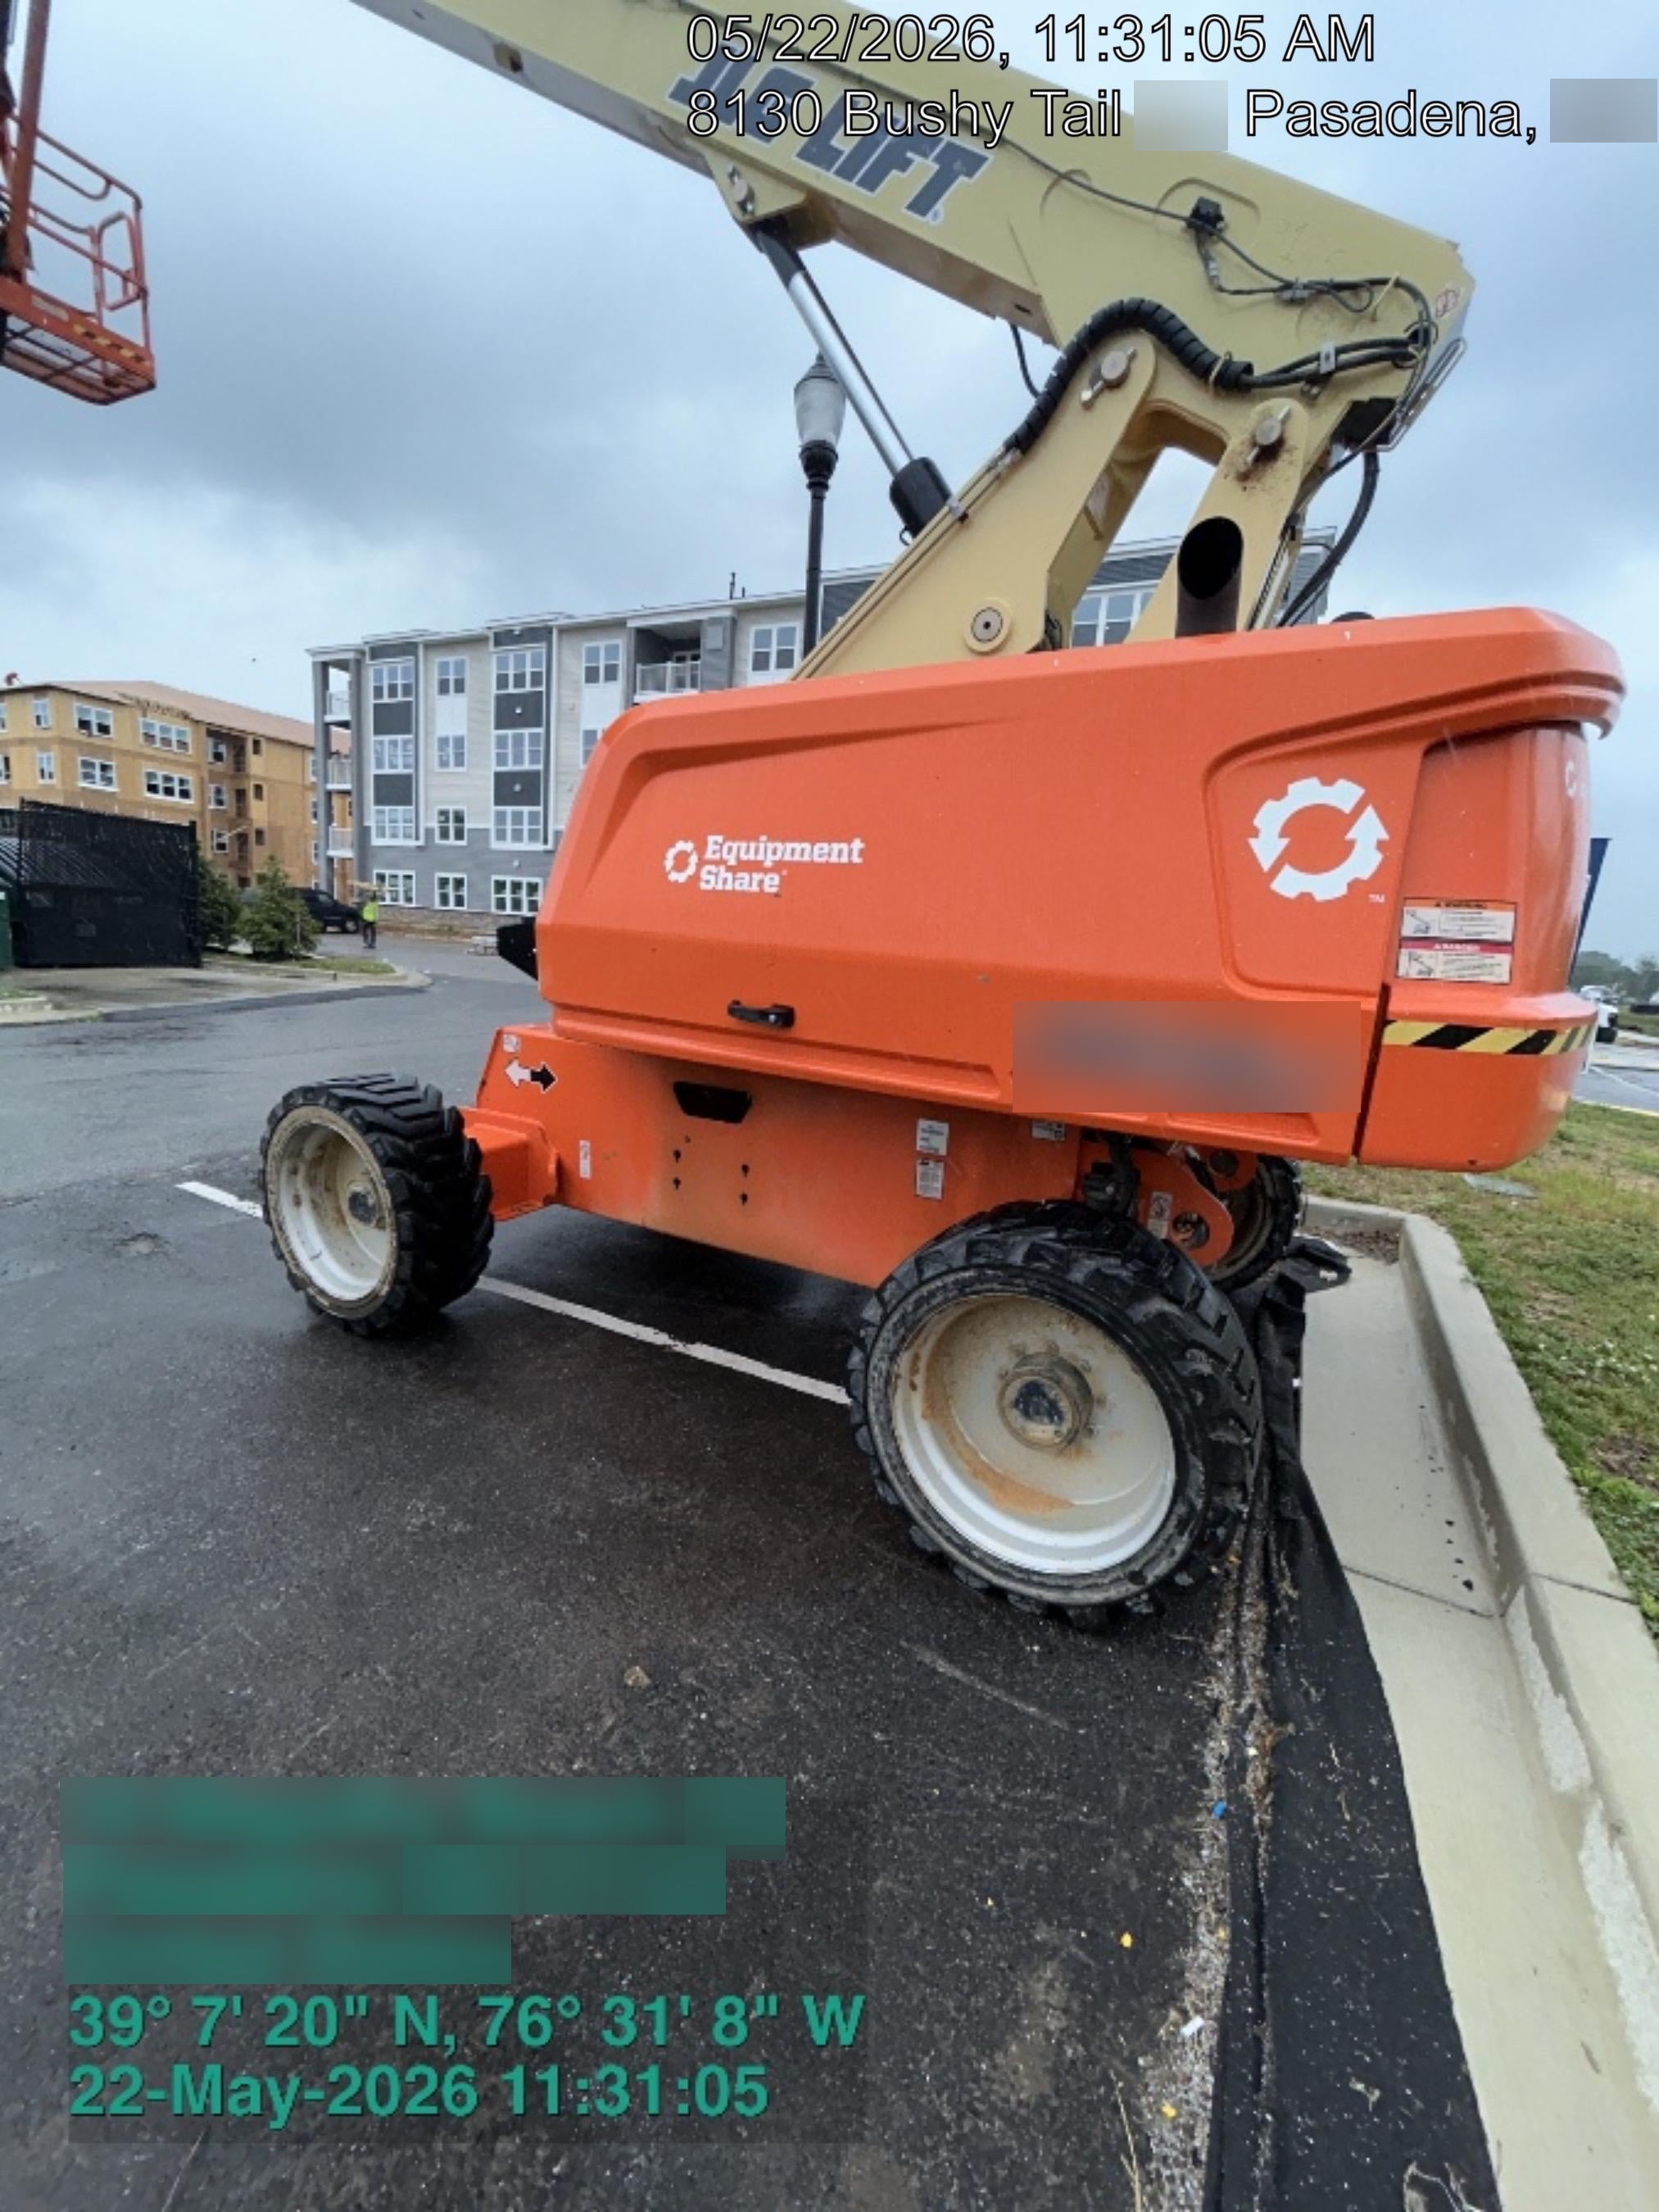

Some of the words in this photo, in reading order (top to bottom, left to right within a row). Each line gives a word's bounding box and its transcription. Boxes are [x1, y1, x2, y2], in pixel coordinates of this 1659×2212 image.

[792, 90, 990, 219] LIFT
[705, 835, 865, 867] Equipment
[699, 864, 781, 893] Share
